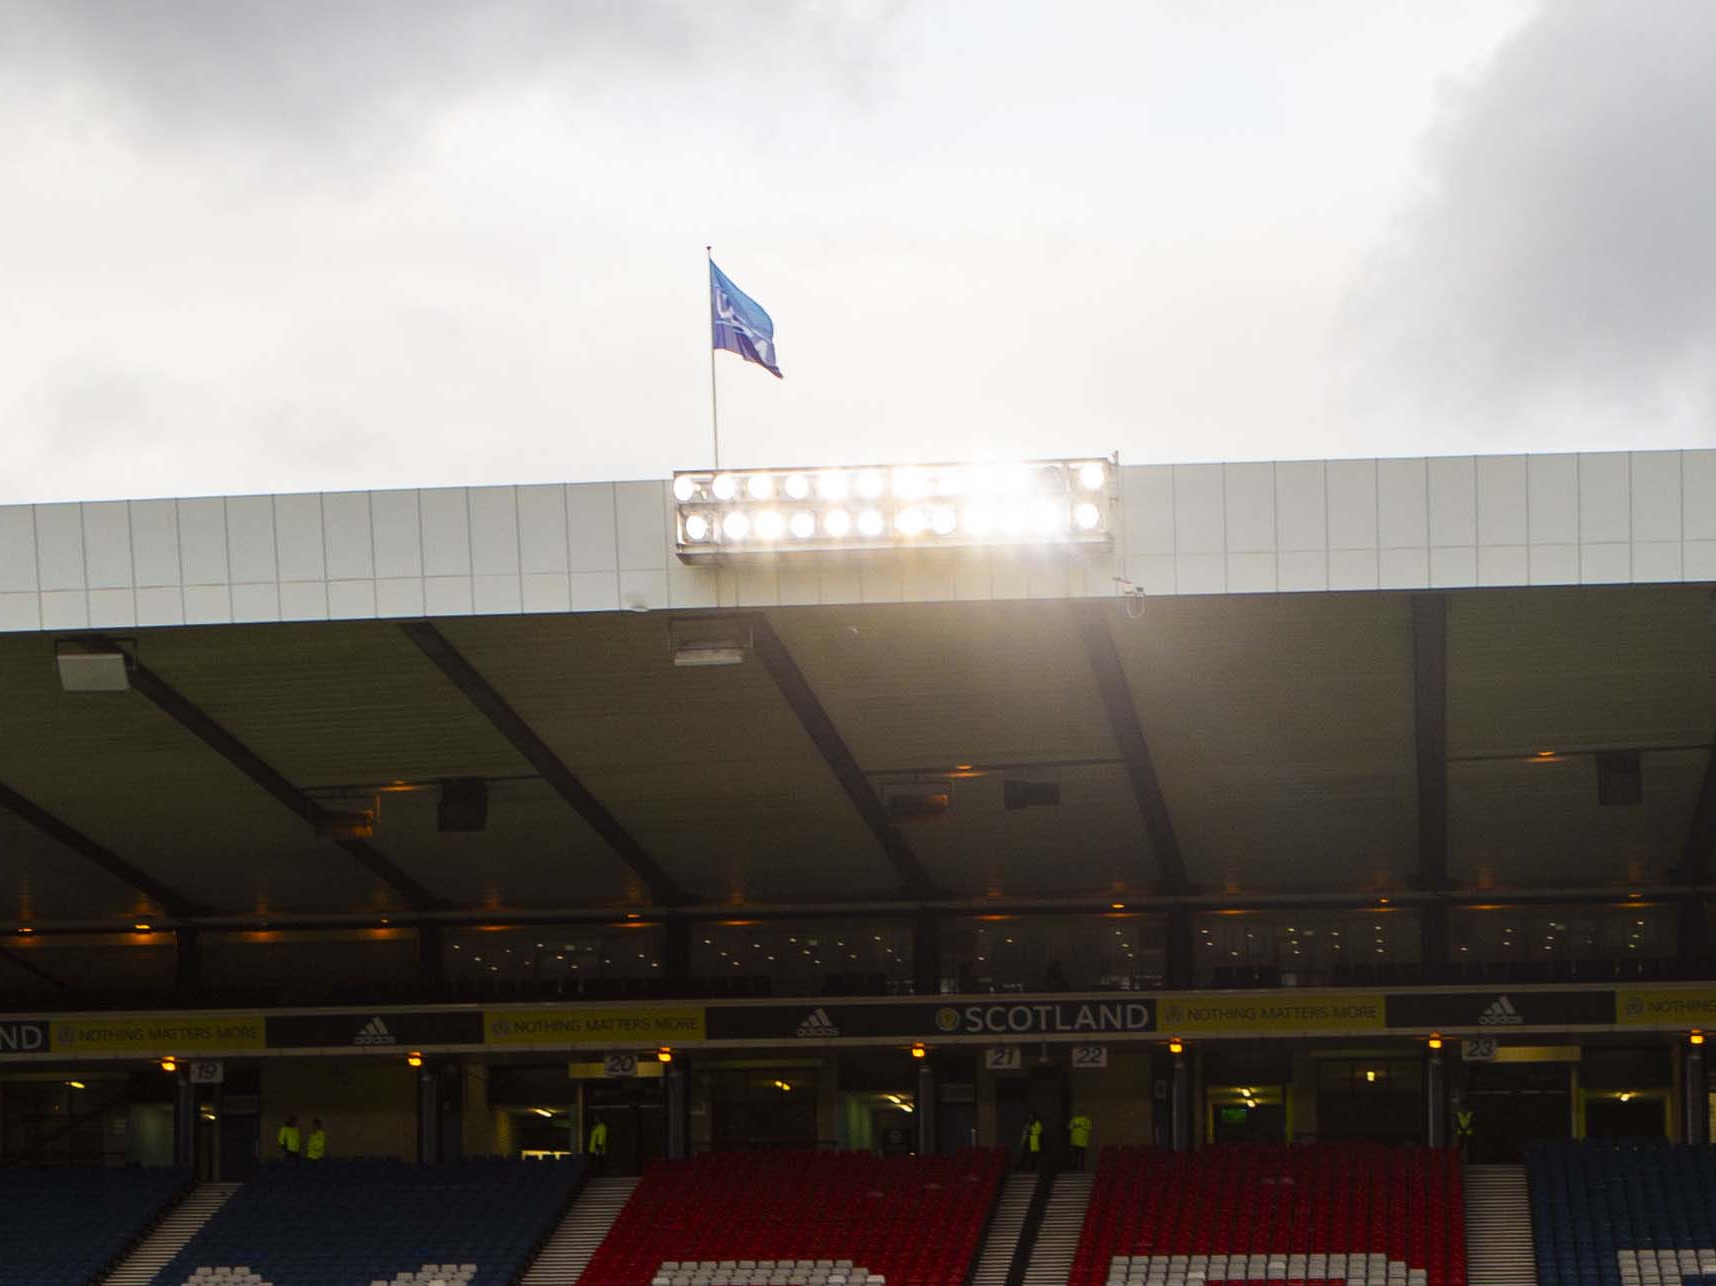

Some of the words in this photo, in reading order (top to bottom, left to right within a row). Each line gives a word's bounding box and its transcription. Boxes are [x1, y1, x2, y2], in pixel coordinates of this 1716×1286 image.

[964, 1004, 1150, 1032] SCOTLAND
[1187, 1008, 1256, 1022] NOTHING
[1261, 1006, 1329, 1020] MATTERS
[1333, 1005, 1378, 1018] MORE
[1478, 1015, 1524, 1025] adidas
[514, 1020, 582, 1034] NOTHING
[585, 1018, 650, 1032] MATTERS
[654, 1017, 699, 1031] MORE
[797, 1027, 840, 1037] adidas
[78, 1028, 144, 1043] NOTHING
[149, 1026, 214, 1041] MATTERS
[218, 1025, 260, 1040] MORE
[993, 1049, 1016, 1065] 21
[1075, 1048, 1102, 1064] 22
[1468, 1042, 1493, 1057] 23
[608, 1056, 635, 1072] 20
[196, 1065, 217, 1080] 19
